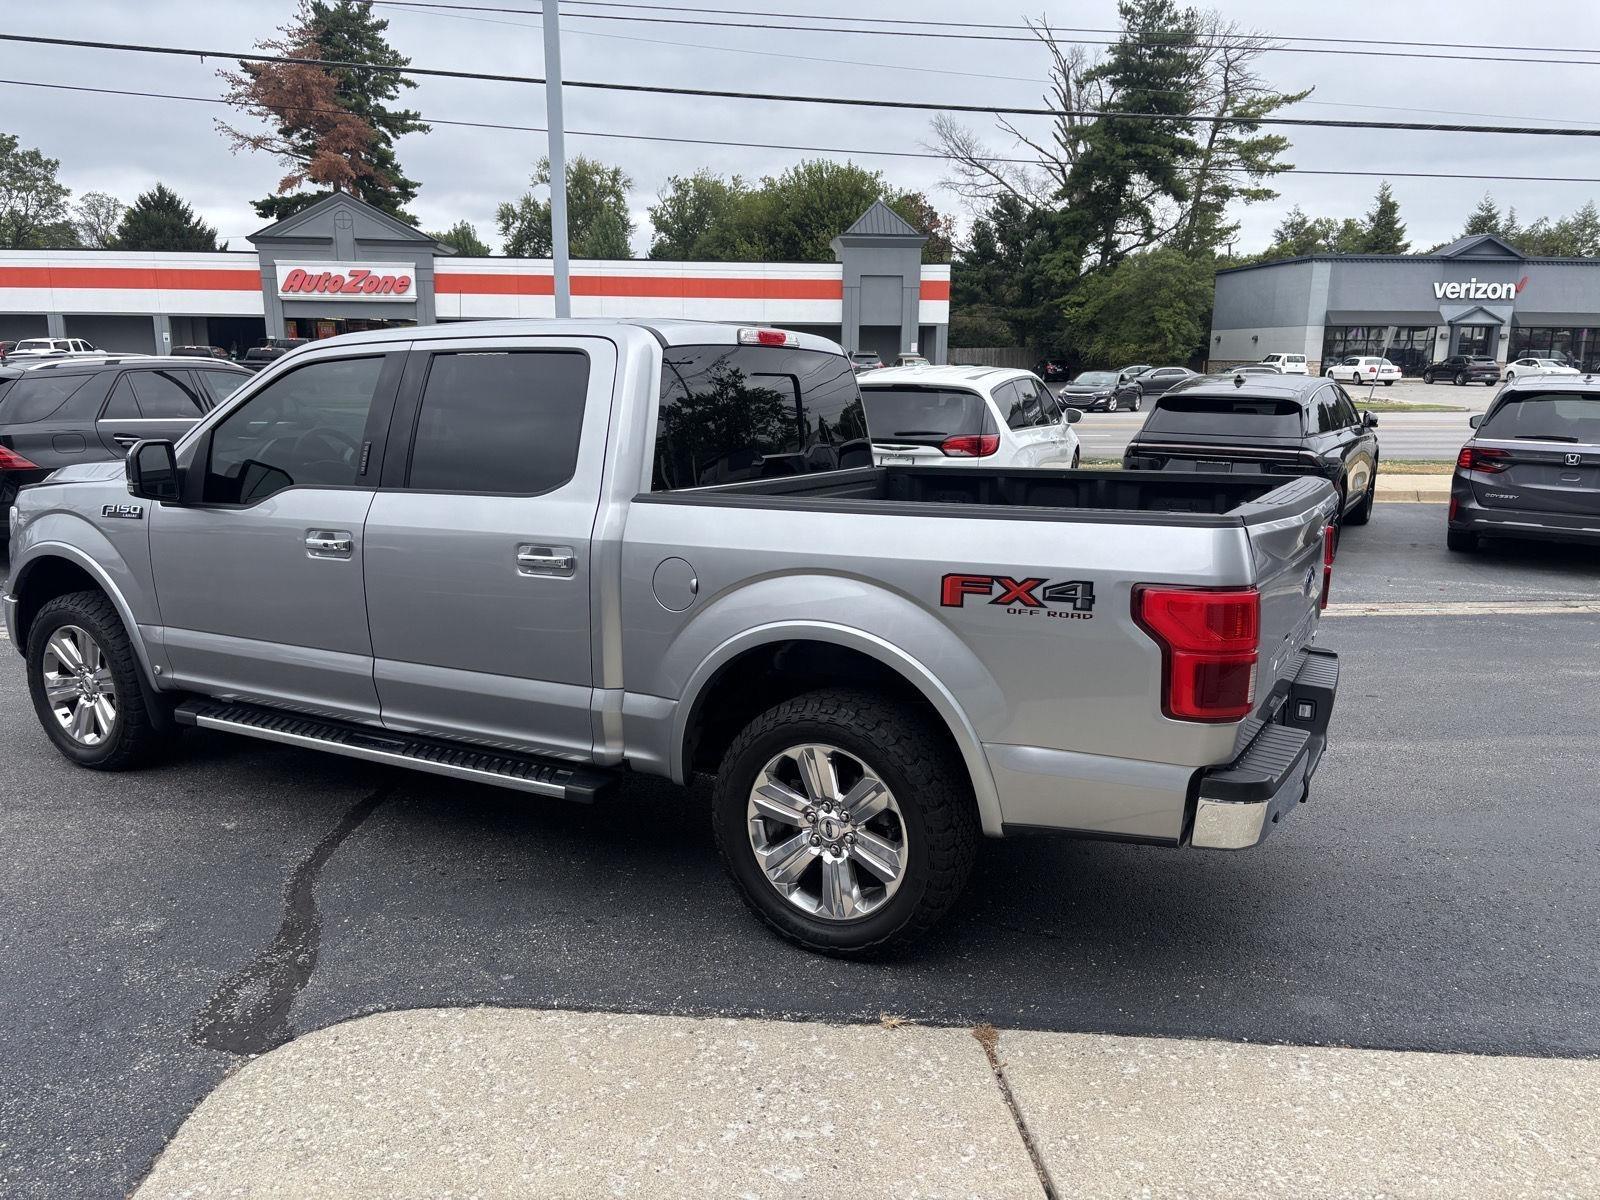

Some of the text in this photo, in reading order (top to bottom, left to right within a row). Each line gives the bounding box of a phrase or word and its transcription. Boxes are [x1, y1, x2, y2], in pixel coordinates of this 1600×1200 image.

[281, 268, 412, 294] AutoZone
[1433, 277, 1517, 299] verizon
[940, 572, 1096, 612] FX4
[1006, 607, 1093, 620] OFF ROAD
